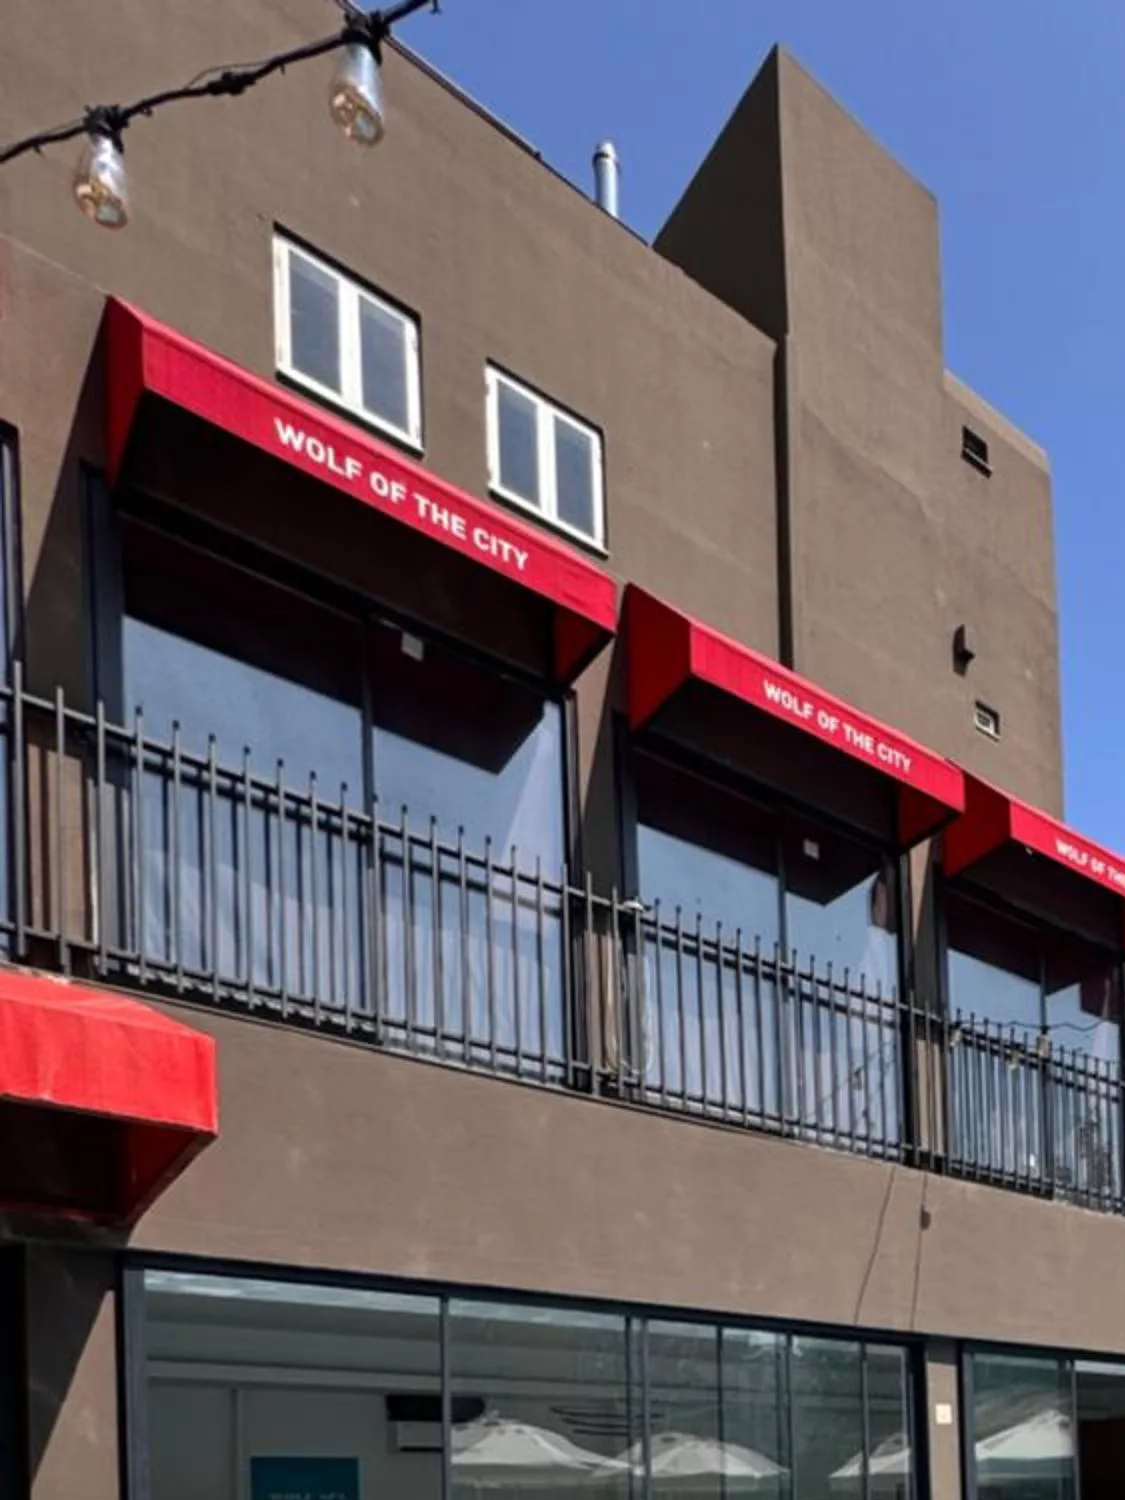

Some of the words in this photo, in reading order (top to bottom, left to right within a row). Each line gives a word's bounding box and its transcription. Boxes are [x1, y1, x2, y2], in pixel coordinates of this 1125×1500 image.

[274, 417, 362, 481] WOLF
[370, 472, 407, 504] OF
[413, 493, 467, 539] THE
[474, 527, 528, 571] CITY
[763, 679, 814, 719] WOLF
[817, 710, 840, 733] OF
[842, 722, 875, 754] THE
[876, 743, 912, 773] CITY
